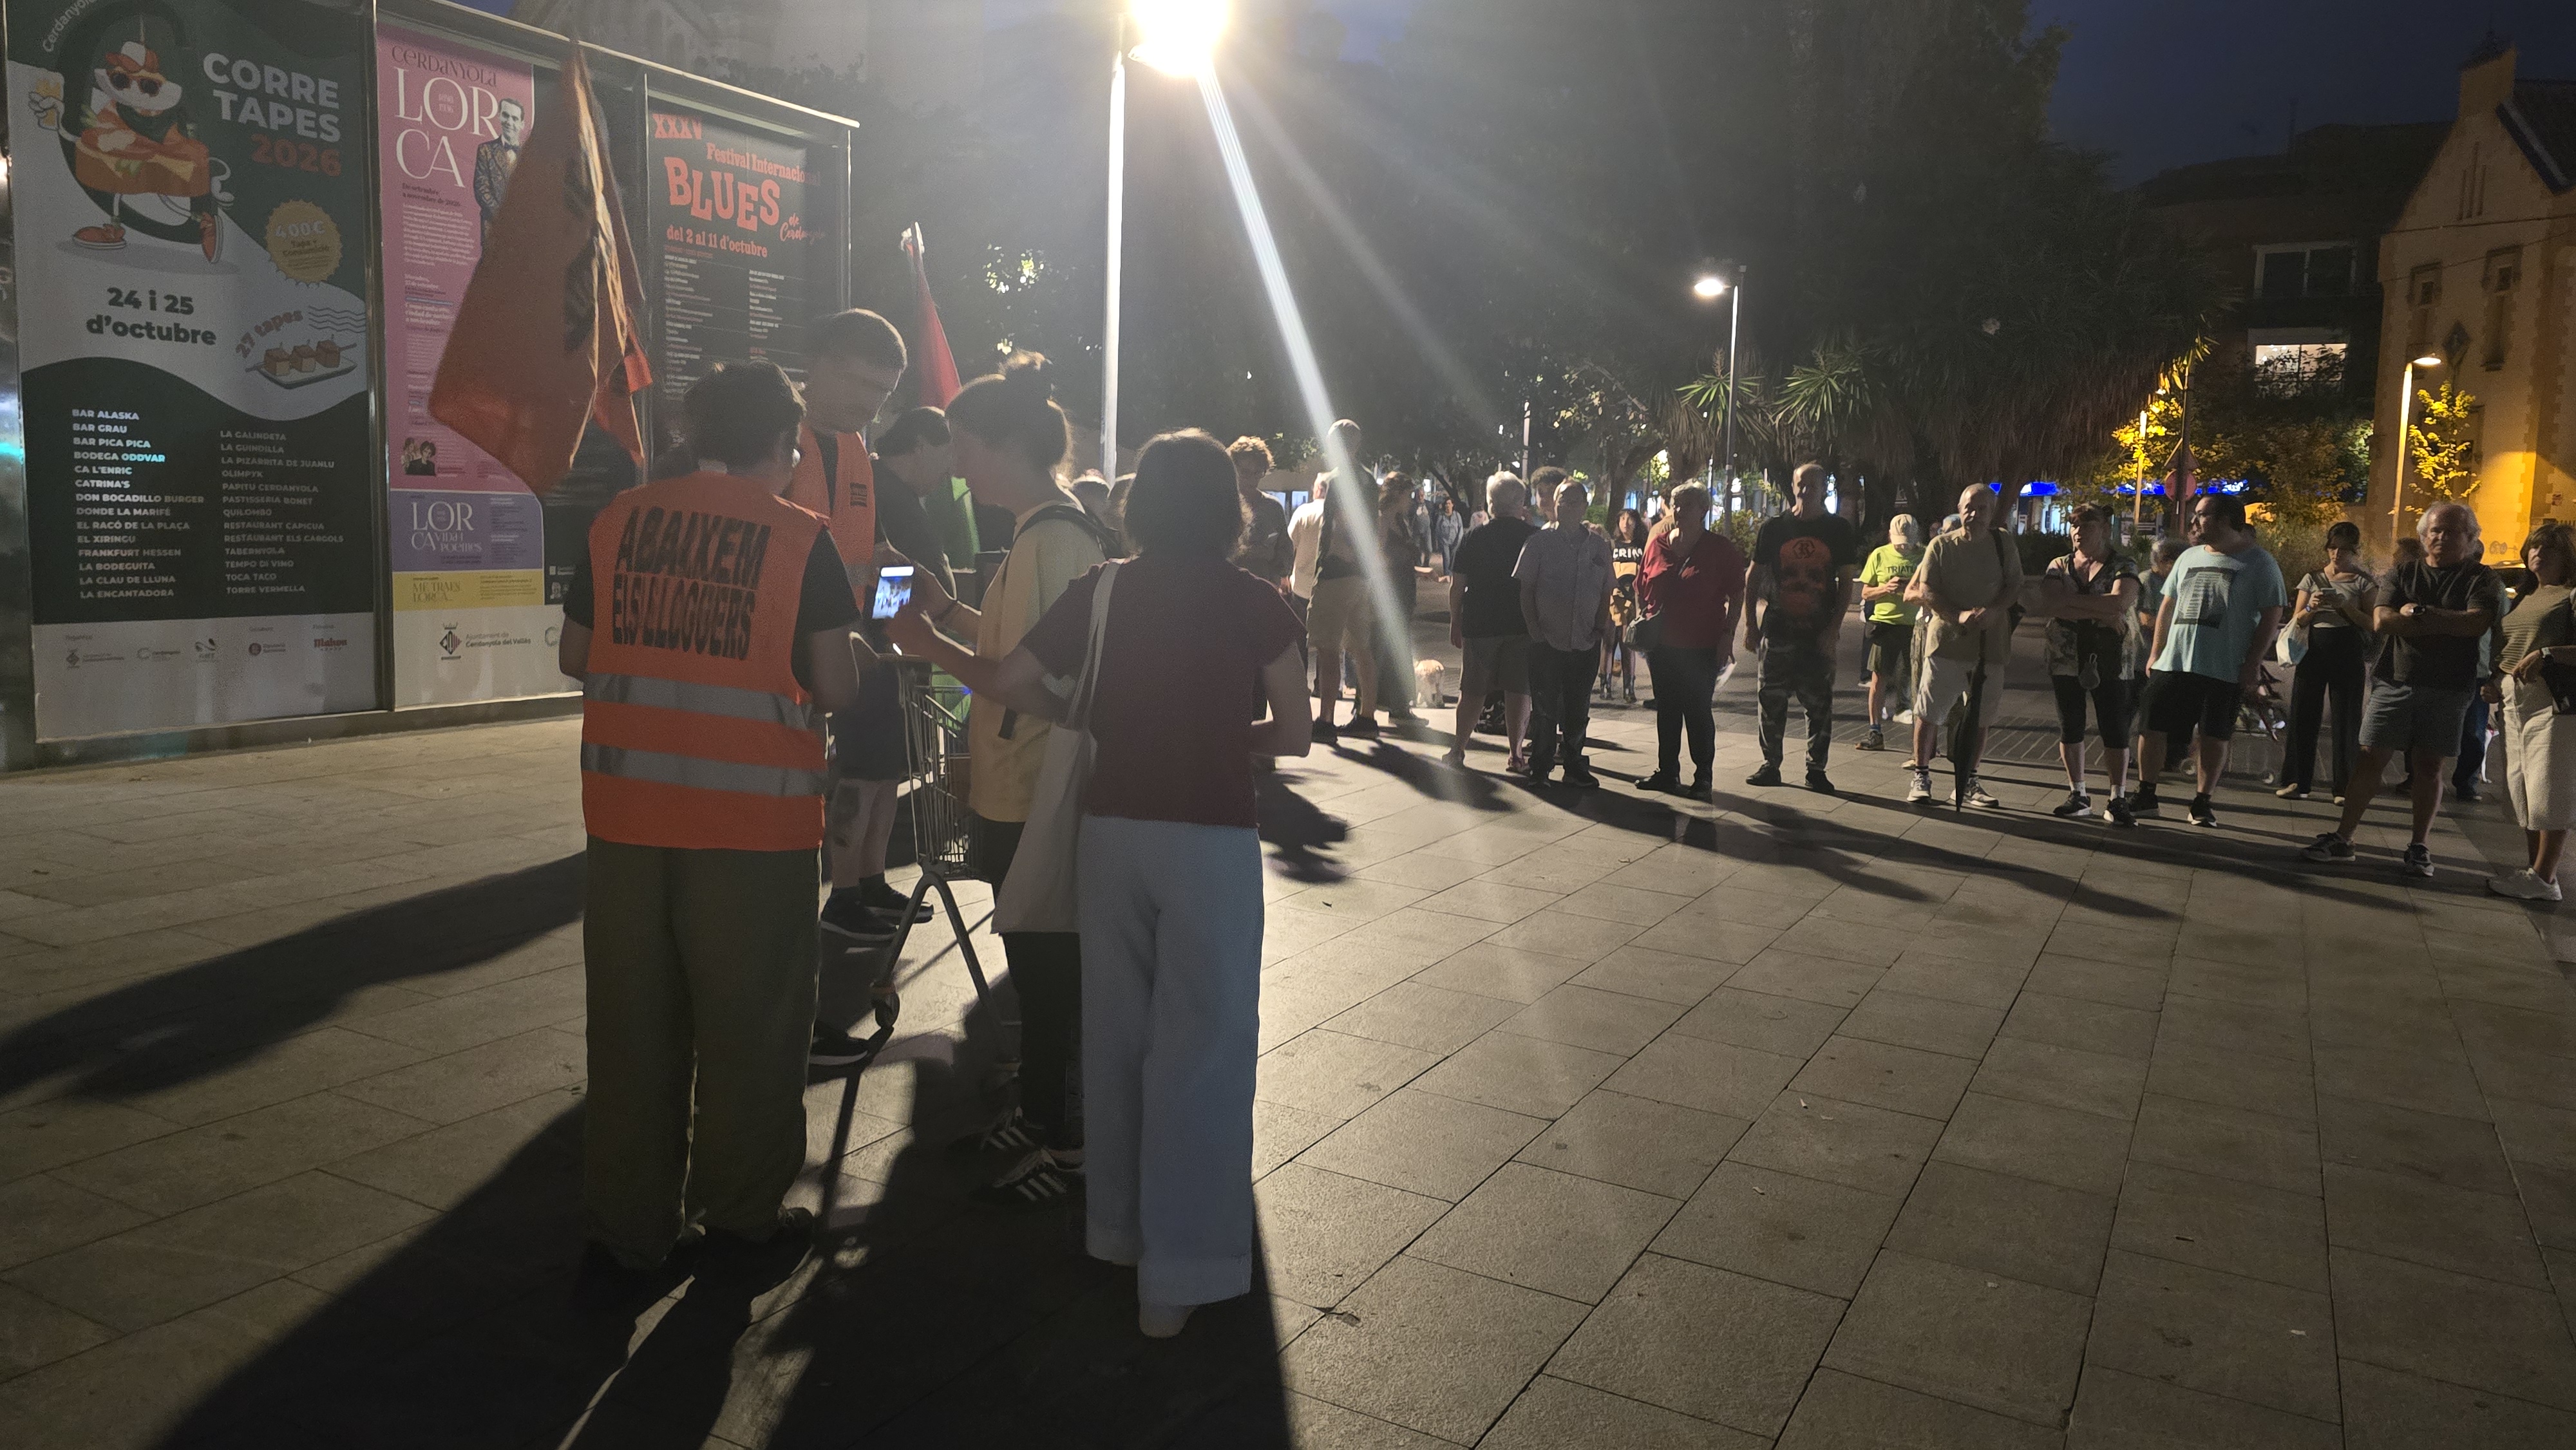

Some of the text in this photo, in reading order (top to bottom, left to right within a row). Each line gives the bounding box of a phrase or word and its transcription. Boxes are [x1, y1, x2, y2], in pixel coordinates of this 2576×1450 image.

[43, 0, 95, 52] Cerdanyo
[203, 53, 339, 109] CORRE
[393, 66, 499, 140] LOR
[213, 89, 341, 143] TAPES
[652, 113, 702, 140] XXXV
[251, 133, 341, 177] 2026
[396, 129, 466, 188] CA
[706, 142, 750, 170] Festival
[664, 156, 781, 232] BLUES
[789, 212, 800, 227] de
[667, 225, 683, 241] del
[686, 231, 693, 245] 2
[696, 231, 706, 247] al
[708, 233, 717, 249] 11
[719, 236, 768, 258] d'octubre
[107, 287, 194, 315] 24 i 25
[86, 314, 216, 346] d'octubre
[236, 310, 303, 359] 27 tapes
[71, 409, 140, 421] BAR ALASKA
[71, 423, 128, 433] BAR GRAU
[220, 430, 232, 438] LA
[72, 437, 151, 448] BAR PICA PICA
[220, 443, 234, 451] LA
[73, 451, 166, 462] BODEGA ODDVAR
[74, 465, 133, 475] CA L'ENRIC
[285, 459, 298, 467] DE
[299, 460, 335, 469] JUANLU
[75, 479, 131, 489] CATRINA'S
[258, 484, 319, 493] CERDANYOLA
[75, 493, 205, 504] DON BOCADILLO BURGER
[76, 506, 171, 516] DONDE LA MARIFÉ
[223, 509, 272, 518] QUILOMBO
[412, 501, 475, 531] LOR
[92, 520, 123, 529] RACÓ
[157, 522, 191, 532] PLAÇA
[93, 535, 137, 544] XIRINGU
[412, 532, 436, 551] CA
[79, 549, 182, 557] FRANKFURT HESSEN
[615, 505, 772, 590] ABAIXEM
[79, 562, 156, 571] LA BODEGUITA
[79, 577, 94, 586] LA
[97, 576, 124, 585] CLAU
[142, 575, 176, 584] LLUNA
[225, 573, 251, 581] TOCA
[79, 589, 175, 599] LA ENCANTADORA
[226, 585, 307, 594] TORRE VERMELLA
[613, 572, 755, 661] ELS LLOGUERS
